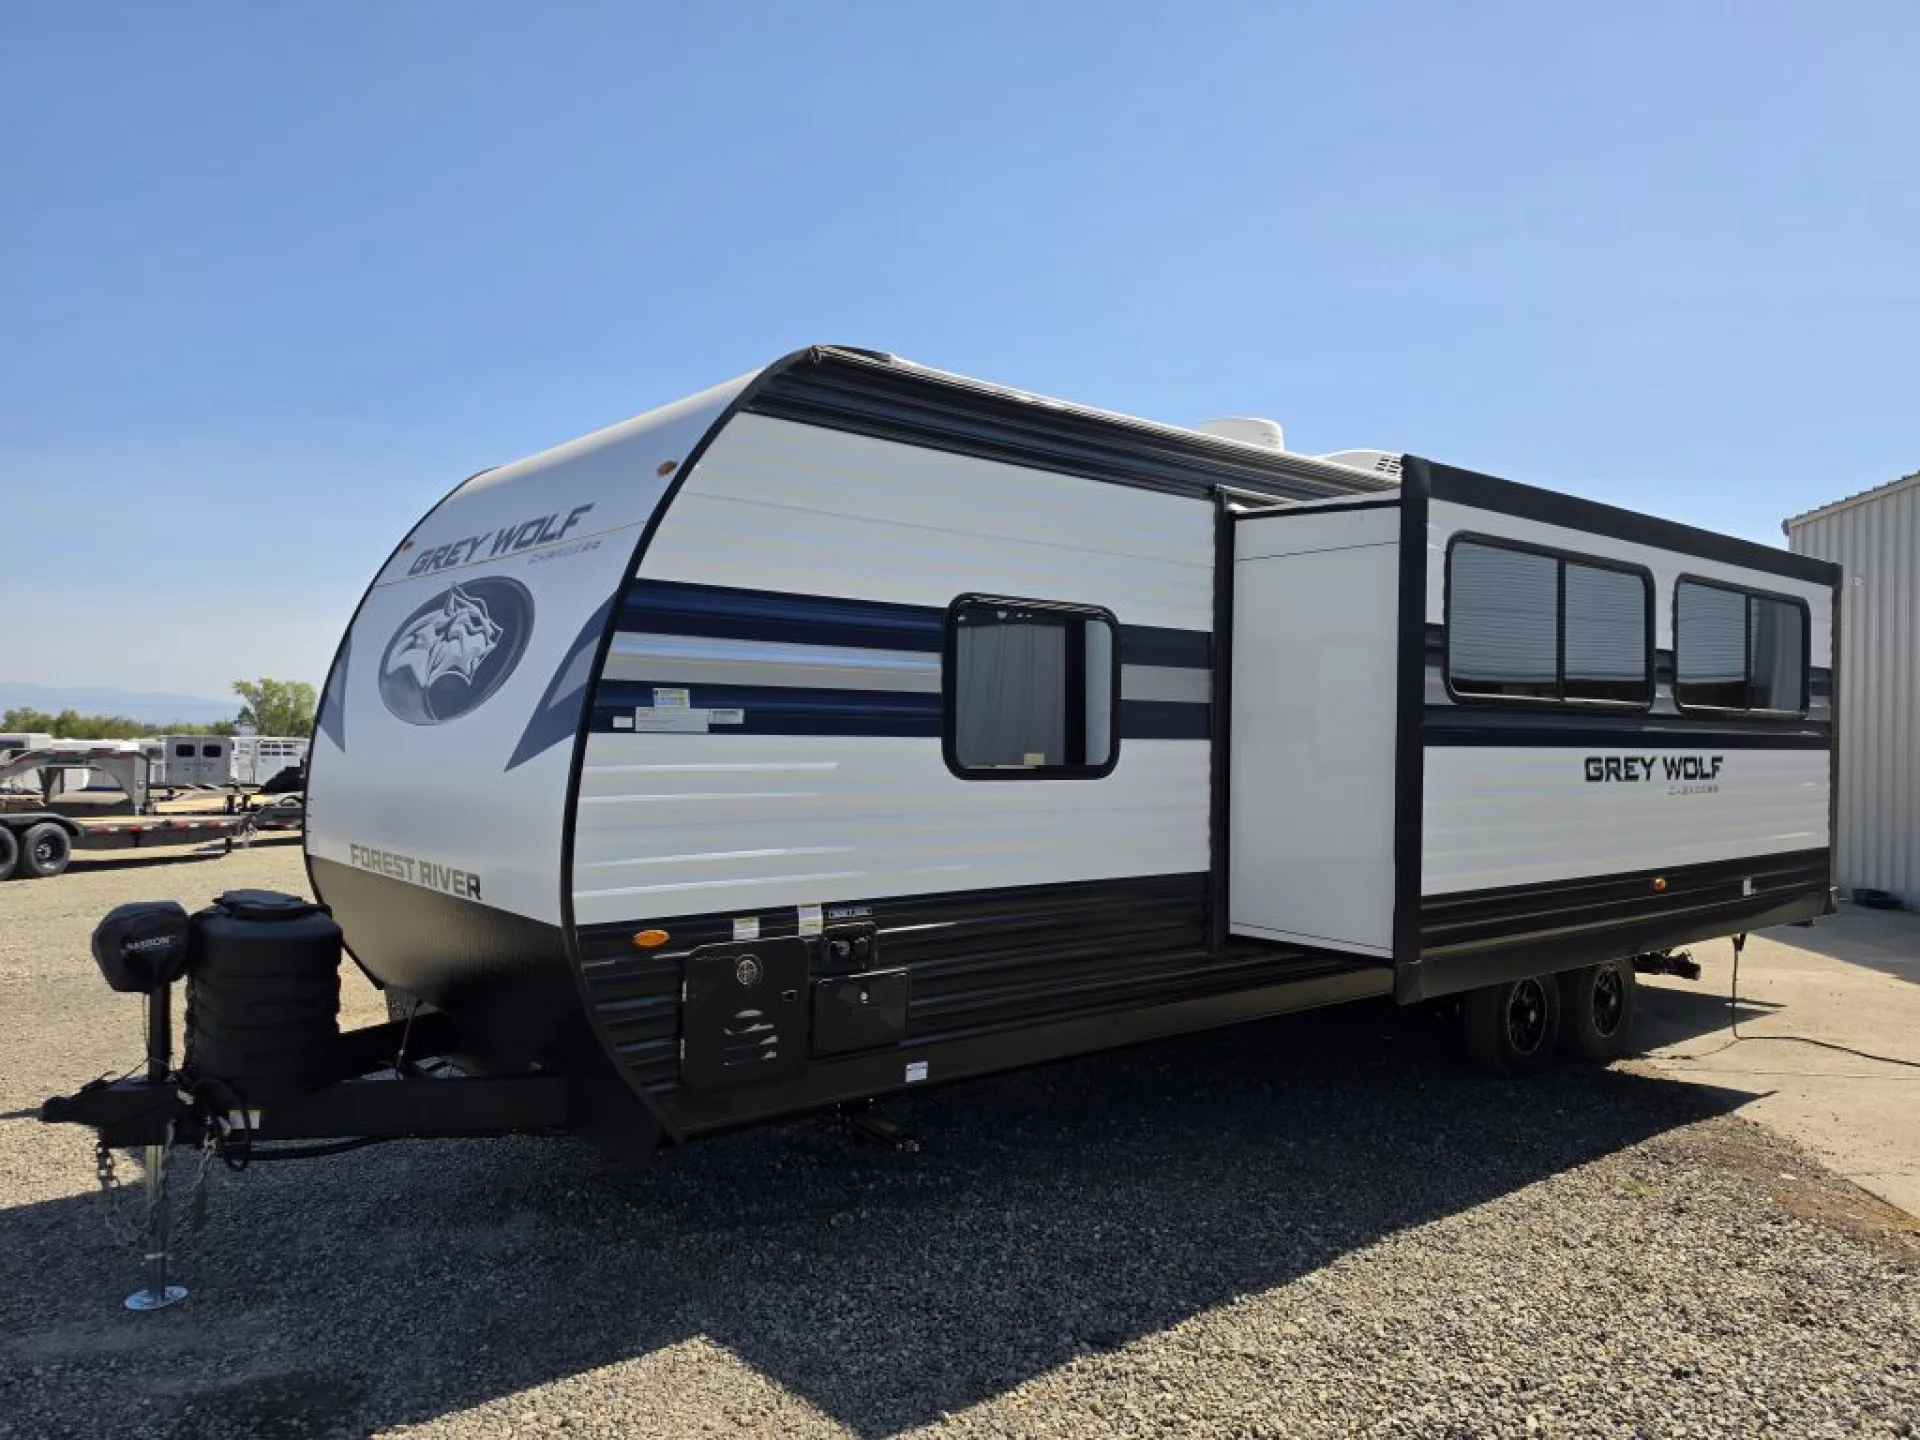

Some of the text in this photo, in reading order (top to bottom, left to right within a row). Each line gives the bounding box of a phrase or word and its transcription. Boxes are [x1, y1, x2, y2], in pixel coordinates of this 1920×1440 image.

[407, 532, 492, 576] GREY
[491, 502, 595, 555] WOLF
[1584, 756, 1723, 782] GREY WOLF
[350, 843, 482, 900] FOREST RIVER
